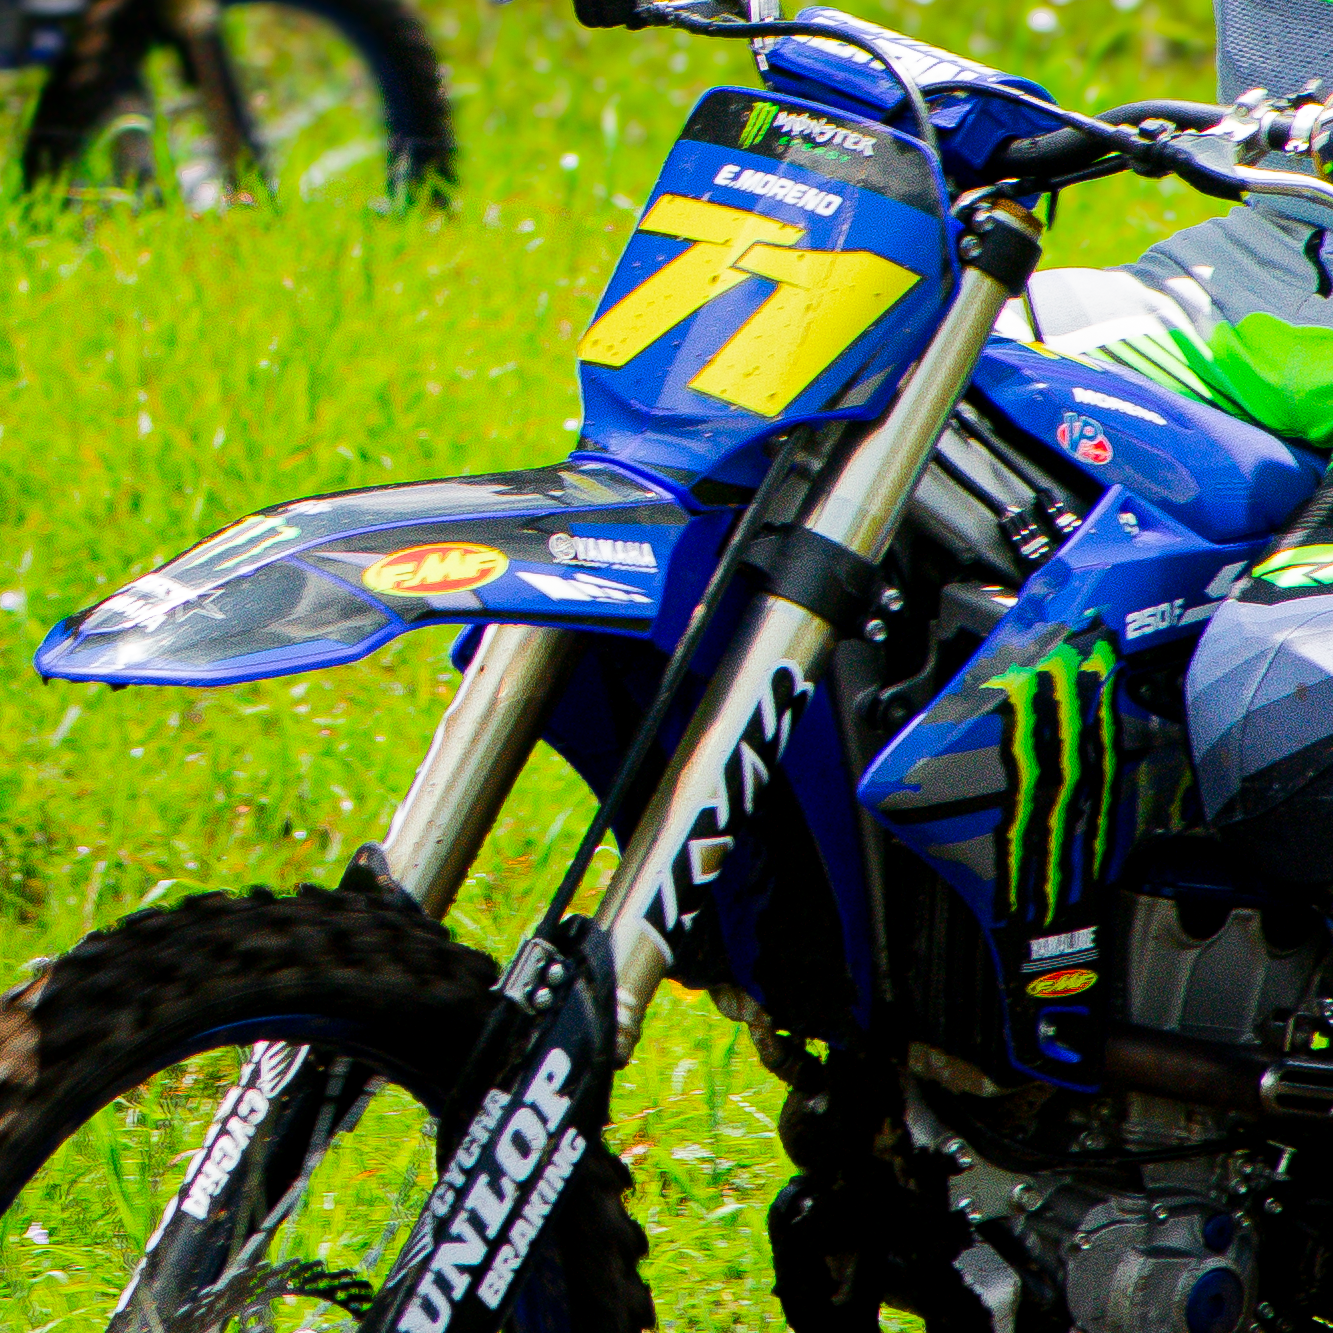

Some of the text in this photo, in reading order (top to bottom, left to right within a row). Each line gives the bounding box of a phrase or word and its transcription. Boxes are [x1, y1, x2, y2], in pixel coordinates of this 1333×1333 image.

[712, 163, 843, 218] E.MORENO
[576, 193, 924, 419] 71
[373, 548, 502, 589] FMF
[180, 1086, 270, 1221] CYCRA
[395, 1046, 572, 1333] UNLOP
[432, 1087, 511, 1219] CYCRA
[475, 1126, 586, 1310] BRAKING
